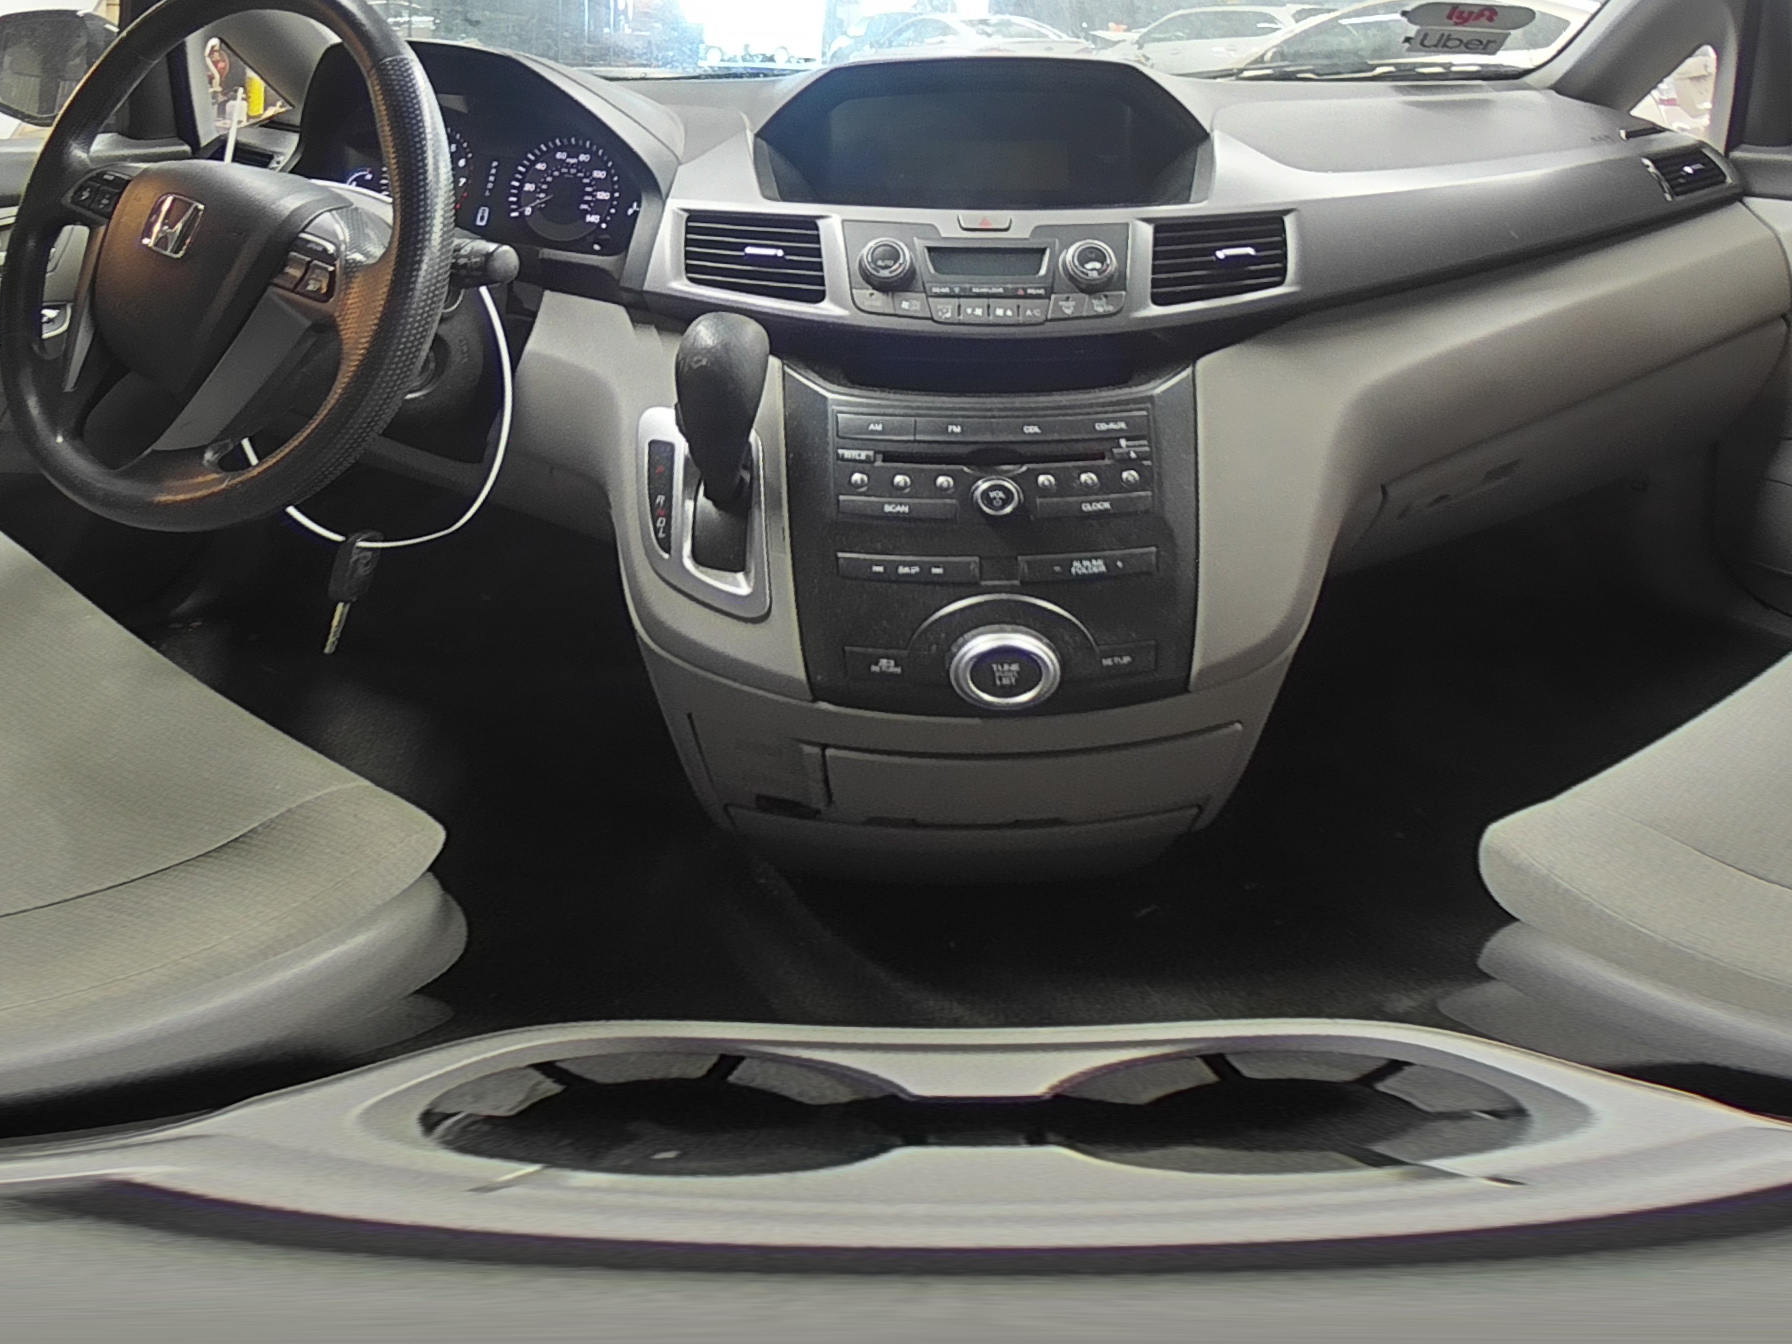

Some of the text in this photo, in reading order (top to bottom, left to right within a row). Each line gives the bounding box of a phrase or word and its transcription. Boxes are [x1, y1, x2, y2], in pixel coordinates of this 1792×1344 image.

[1446, 5, 1498, 26] lyft
[1419, 32, 1496, 51] Uber
[868, 423, 883, 431] AM
[947, 424, 962, 433] FM
[655, 494, 666, 508] R
[1081, 501, 1111, 512] CLOCK
[883, 503, 909, 513] SCAN
[656, 516, 666, 527] D
[658, 528, 666, 539] L
[991, 663, 1020, 671] TUNE
